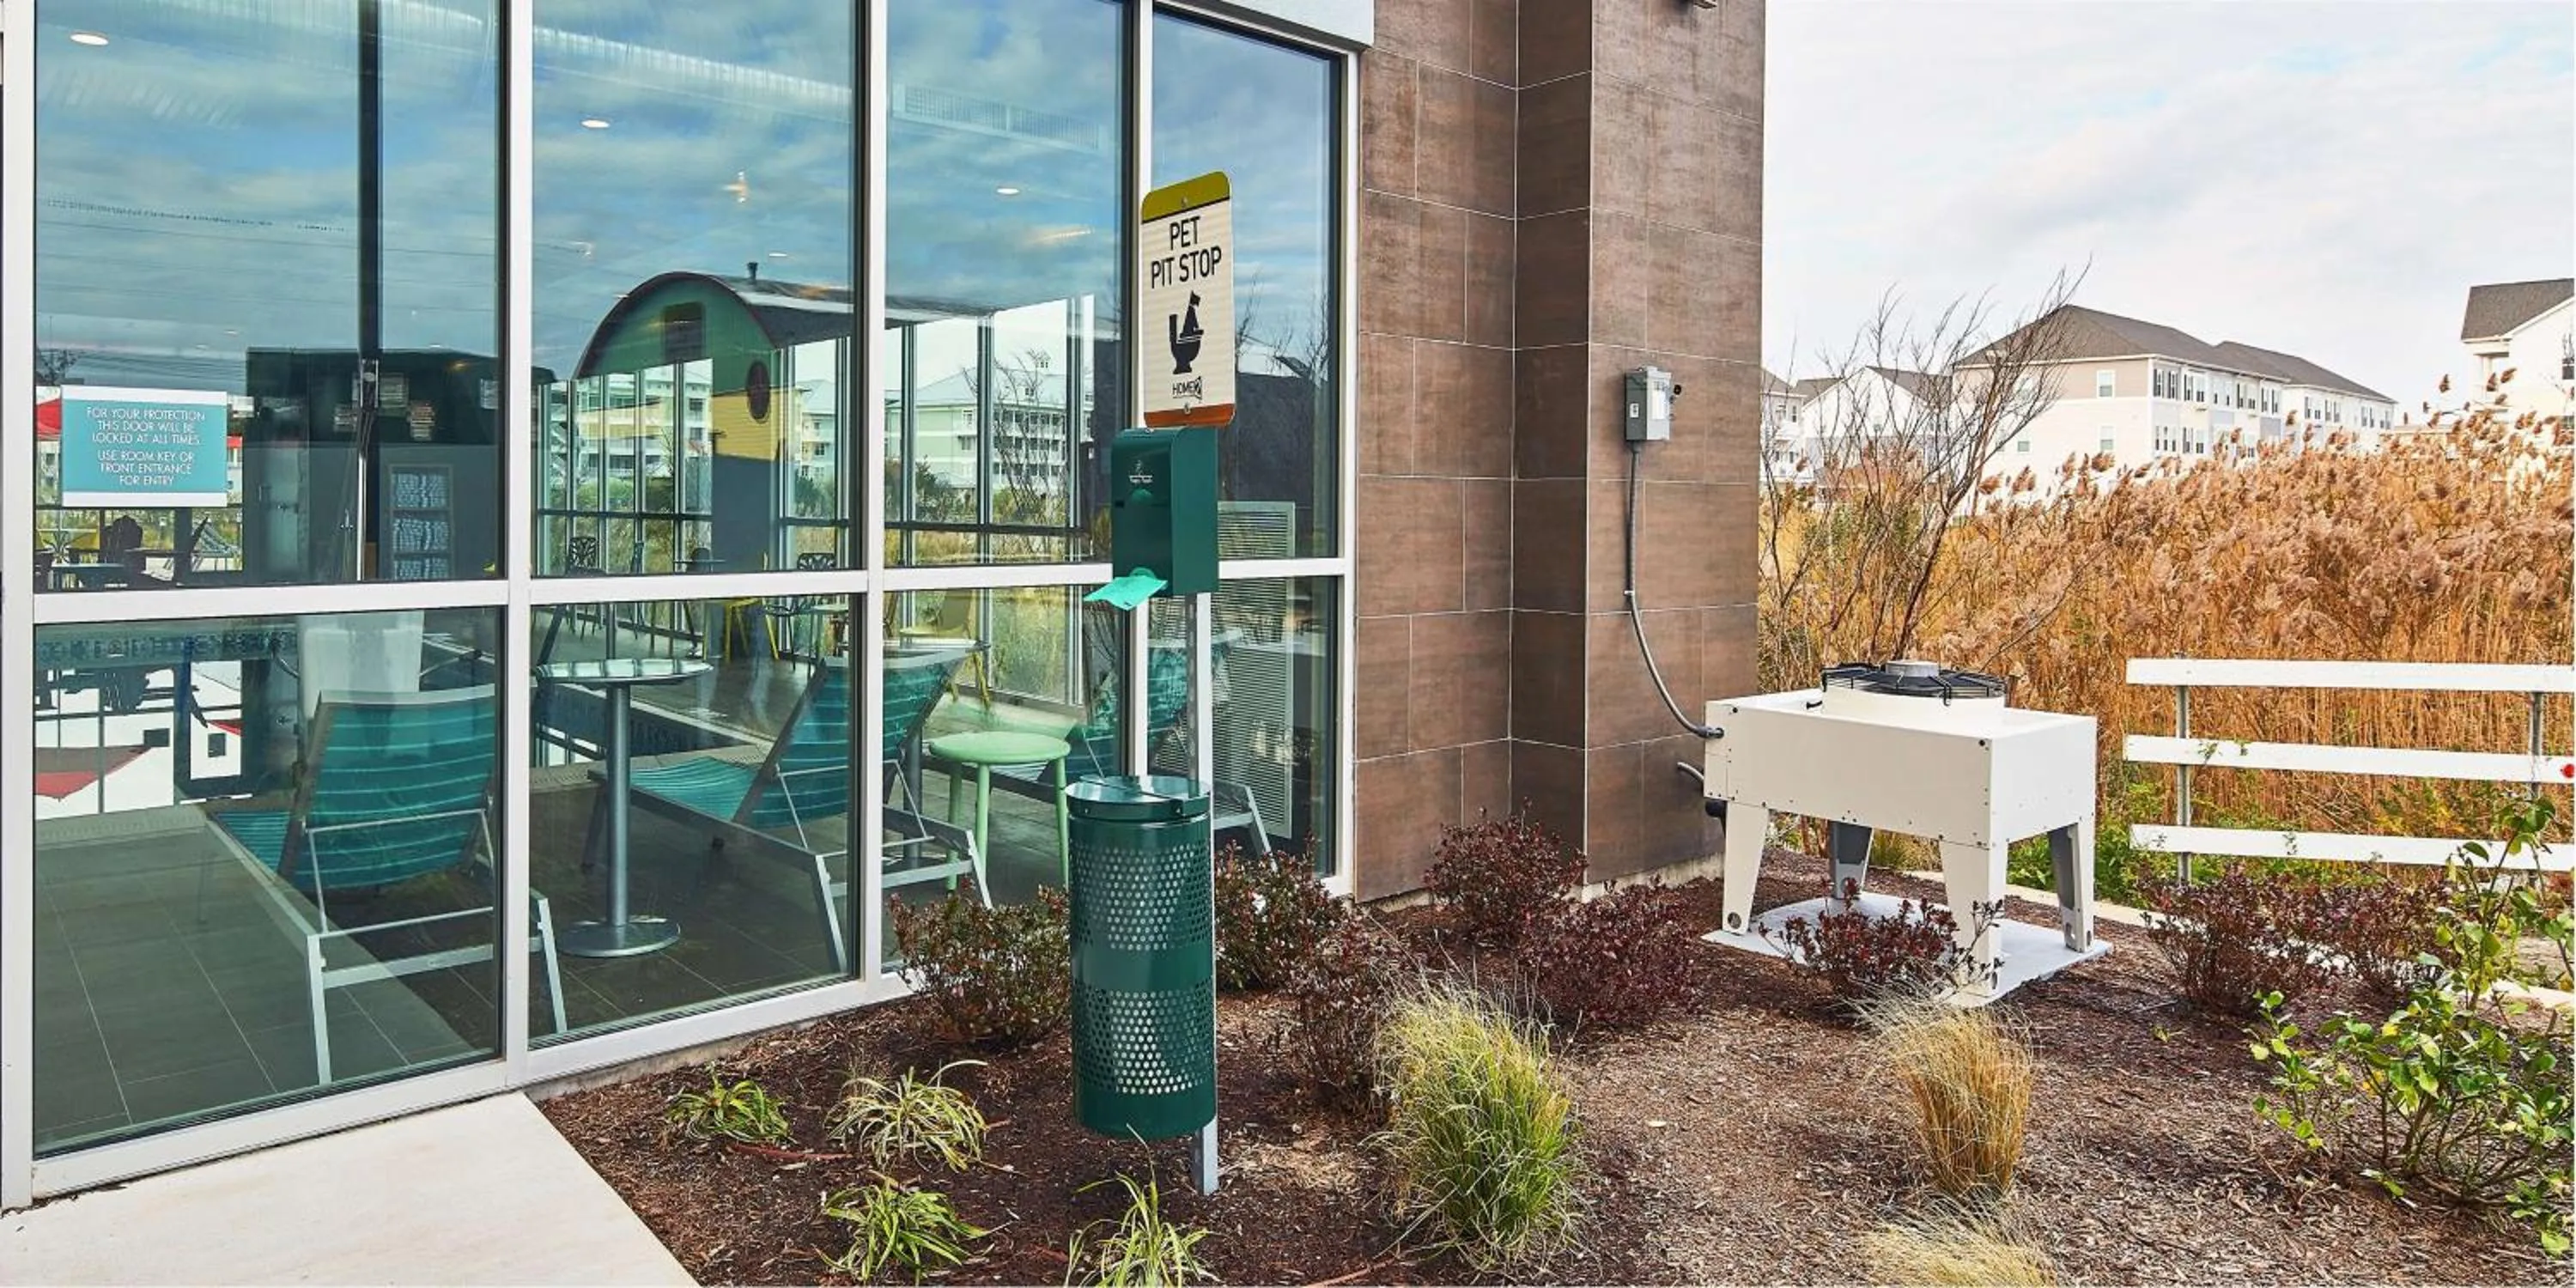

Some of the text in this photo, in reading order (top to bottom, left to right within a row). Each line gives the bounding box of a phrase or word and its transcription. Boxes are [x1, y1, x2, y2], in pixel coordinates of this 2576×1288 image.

[1169, 216, 1200, 251] PET
[1151, 246, 1222, 289] PIT STOP
[87, 407, 205, 421] FOR YOUR PROTECTION
[97, 421, 194, 433] THIS DOOR WILL BE
[92, 432, 132, 443] LOCKED
[137, 433, 149, 443] AT
[152, 433, 168, 444] ALL
[97, 450, 194, 462] USE ROOM KEY OR
[100, 462, 192, 474] FRONT ENTRANCE
[119, 475, 174, 486] FOR ENTRY
